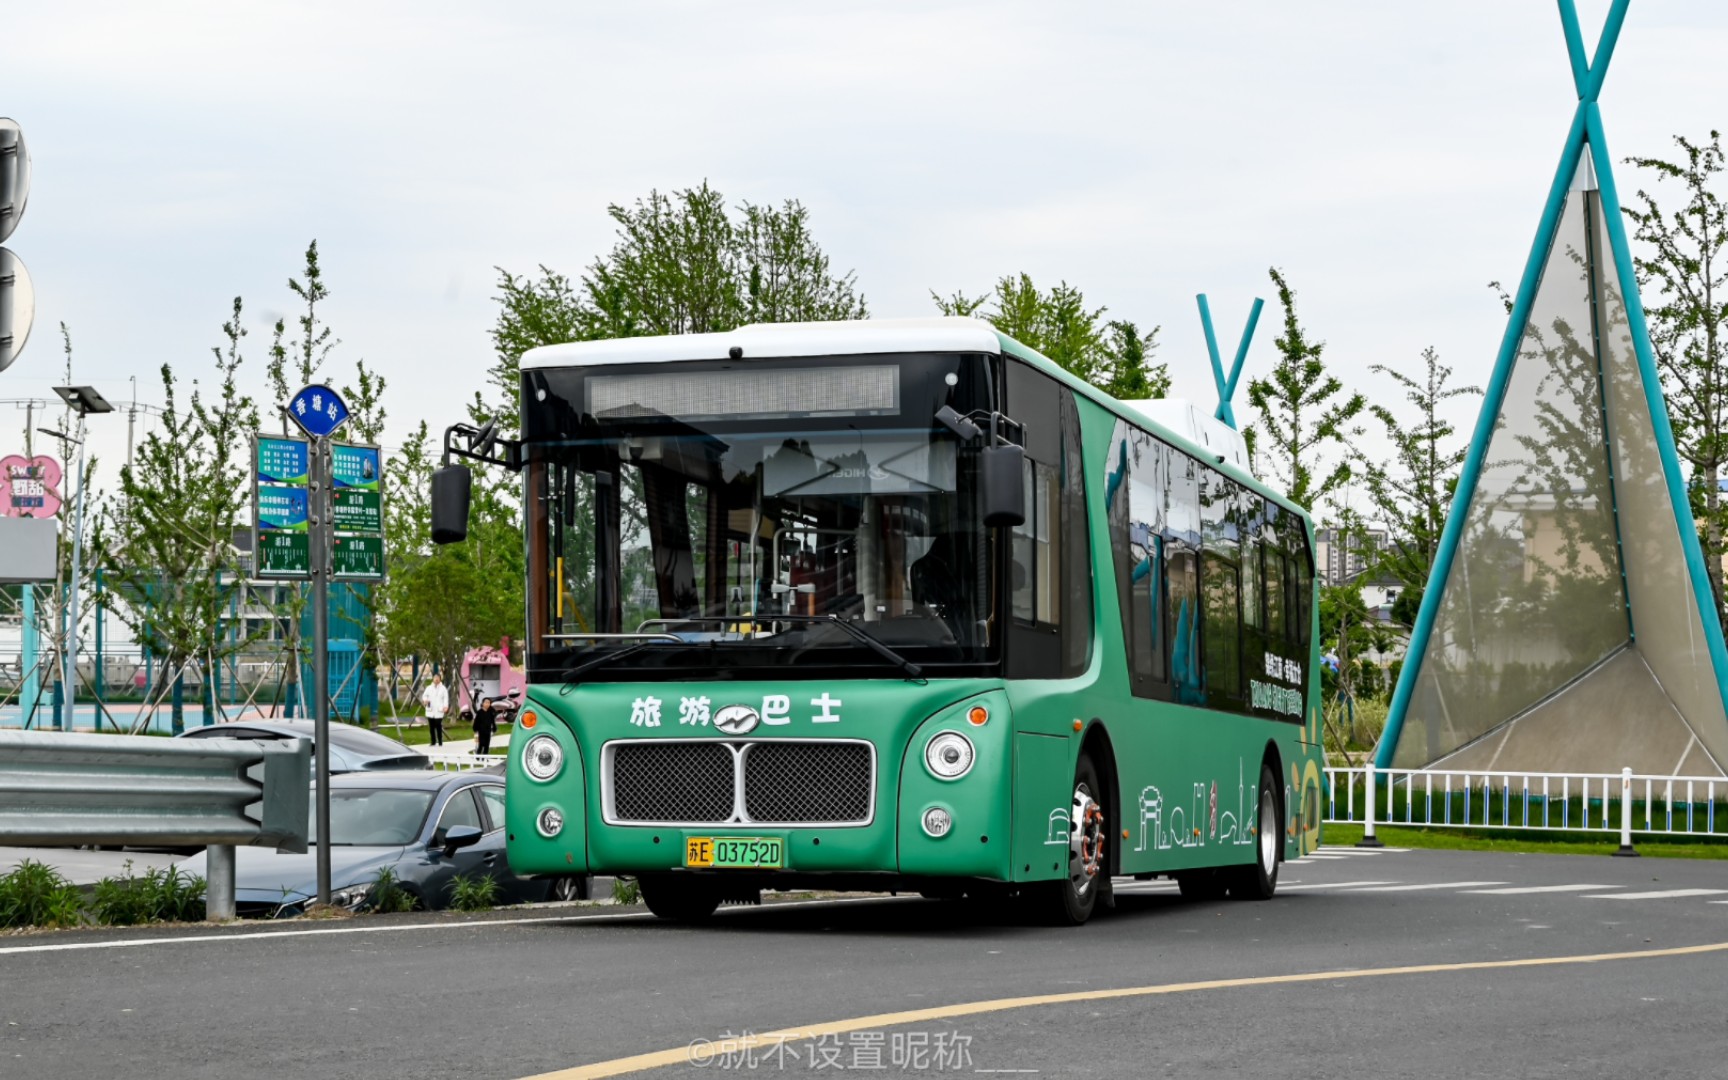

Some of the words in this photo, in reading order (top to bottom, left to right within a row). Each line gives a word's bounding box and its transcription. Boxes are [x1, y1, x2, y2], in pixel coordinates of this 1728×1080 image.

[296, 394, 338, 421] 香塘站
[629, 692, 842, 727] 旅游巴士
